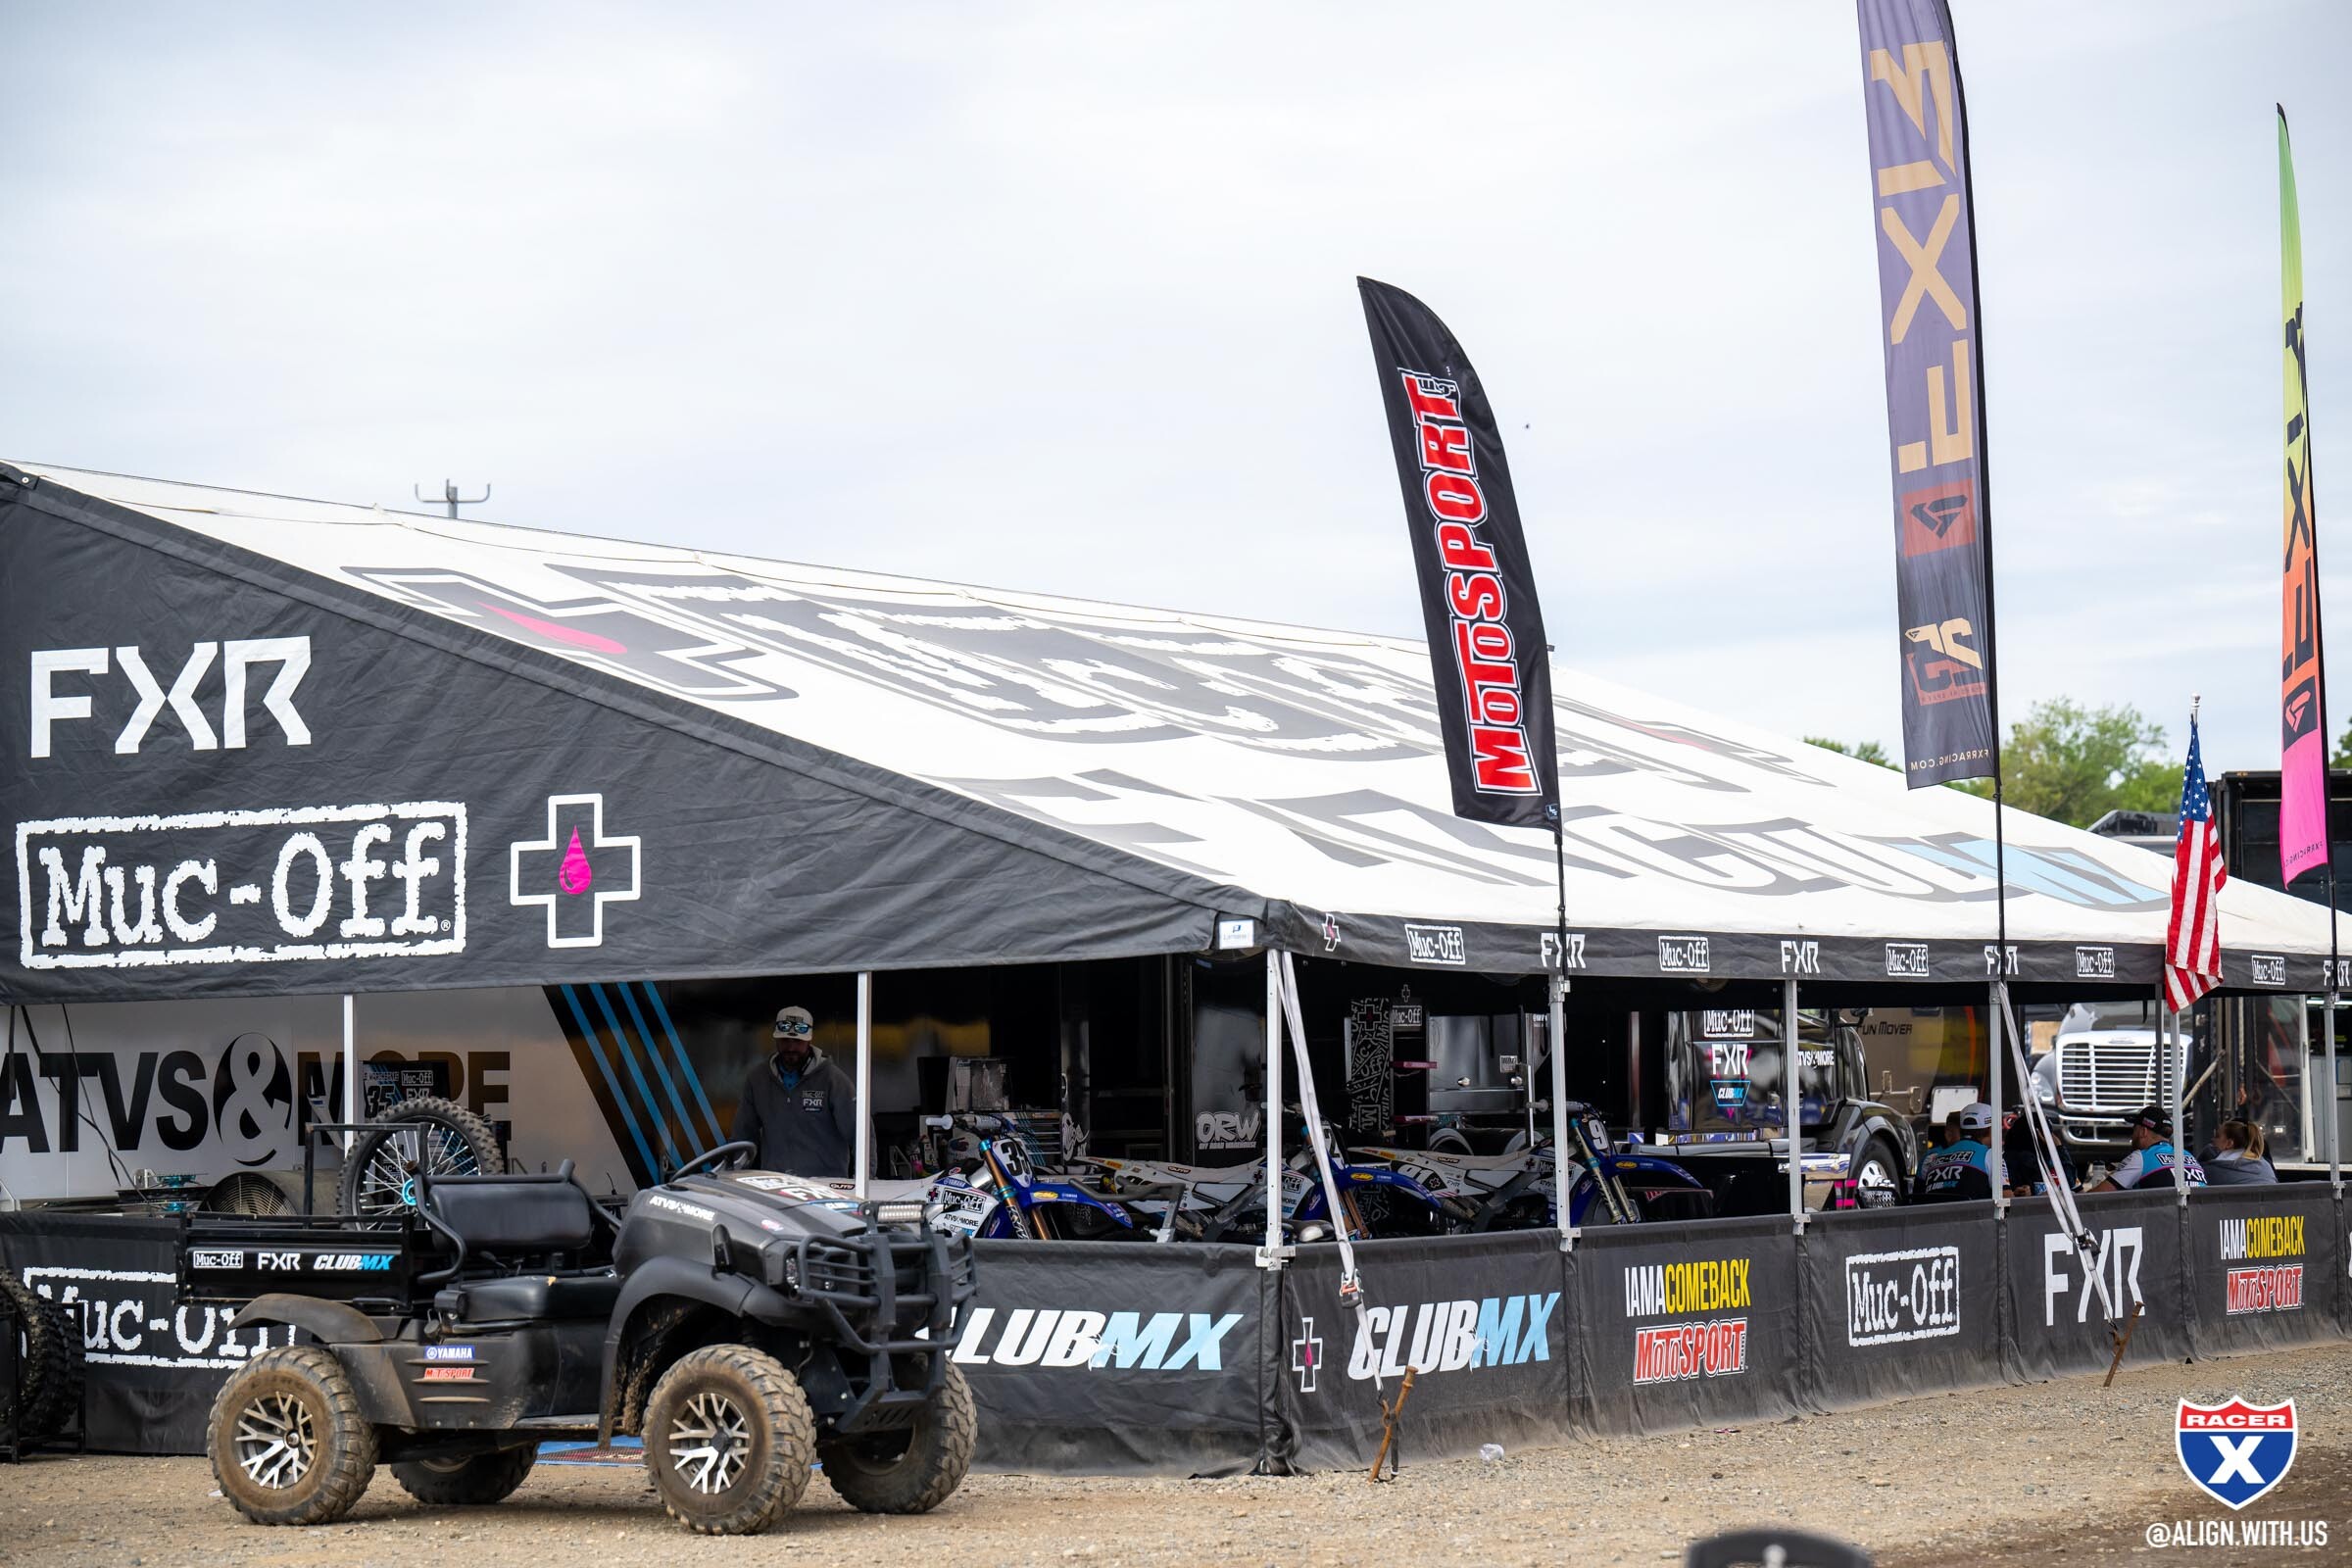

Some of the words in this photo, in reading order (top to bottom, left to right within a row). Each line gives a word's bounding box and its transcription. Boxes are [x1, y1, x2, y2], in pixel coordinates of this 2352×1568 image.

[31, 635, 312, 759] FXR
[39, 820, 447, 948] Muc-Off
[1410, 930, 1463, 961] Muc-Off
[1661, 941, 1708, 969] Muc-Off
[1781, 941, 1820, 973] FXR
[1887, 947, 1928, 973] Muc-Off
[2078, 949, 2113, 974] Muc-Off
[2253, 957, 2284, 983] Muc-Off
[1711, 1044, 1749, 1075] FXR
[803, 1098, 823, 1106] FXR
[1197, 1110, 1260, 1143] ORW
[1926, 1166, 1963, 1186] FXR
[196, 1253, 241, 1266] Muc-Off
[258, 1253, 301, 1270] FXR
[313, 1254, 395, 1271] CLUBMX
[2044, 1227, 2146, 1326] FXR
[1851, 1257, 1955, 1334] Muc-Off
[916, 1307, 1243, 1372] LUBMX
[1348, 1292, 1560, 1381] CLUBMX
[437, 1348, 472, 1359] YAMAHA
